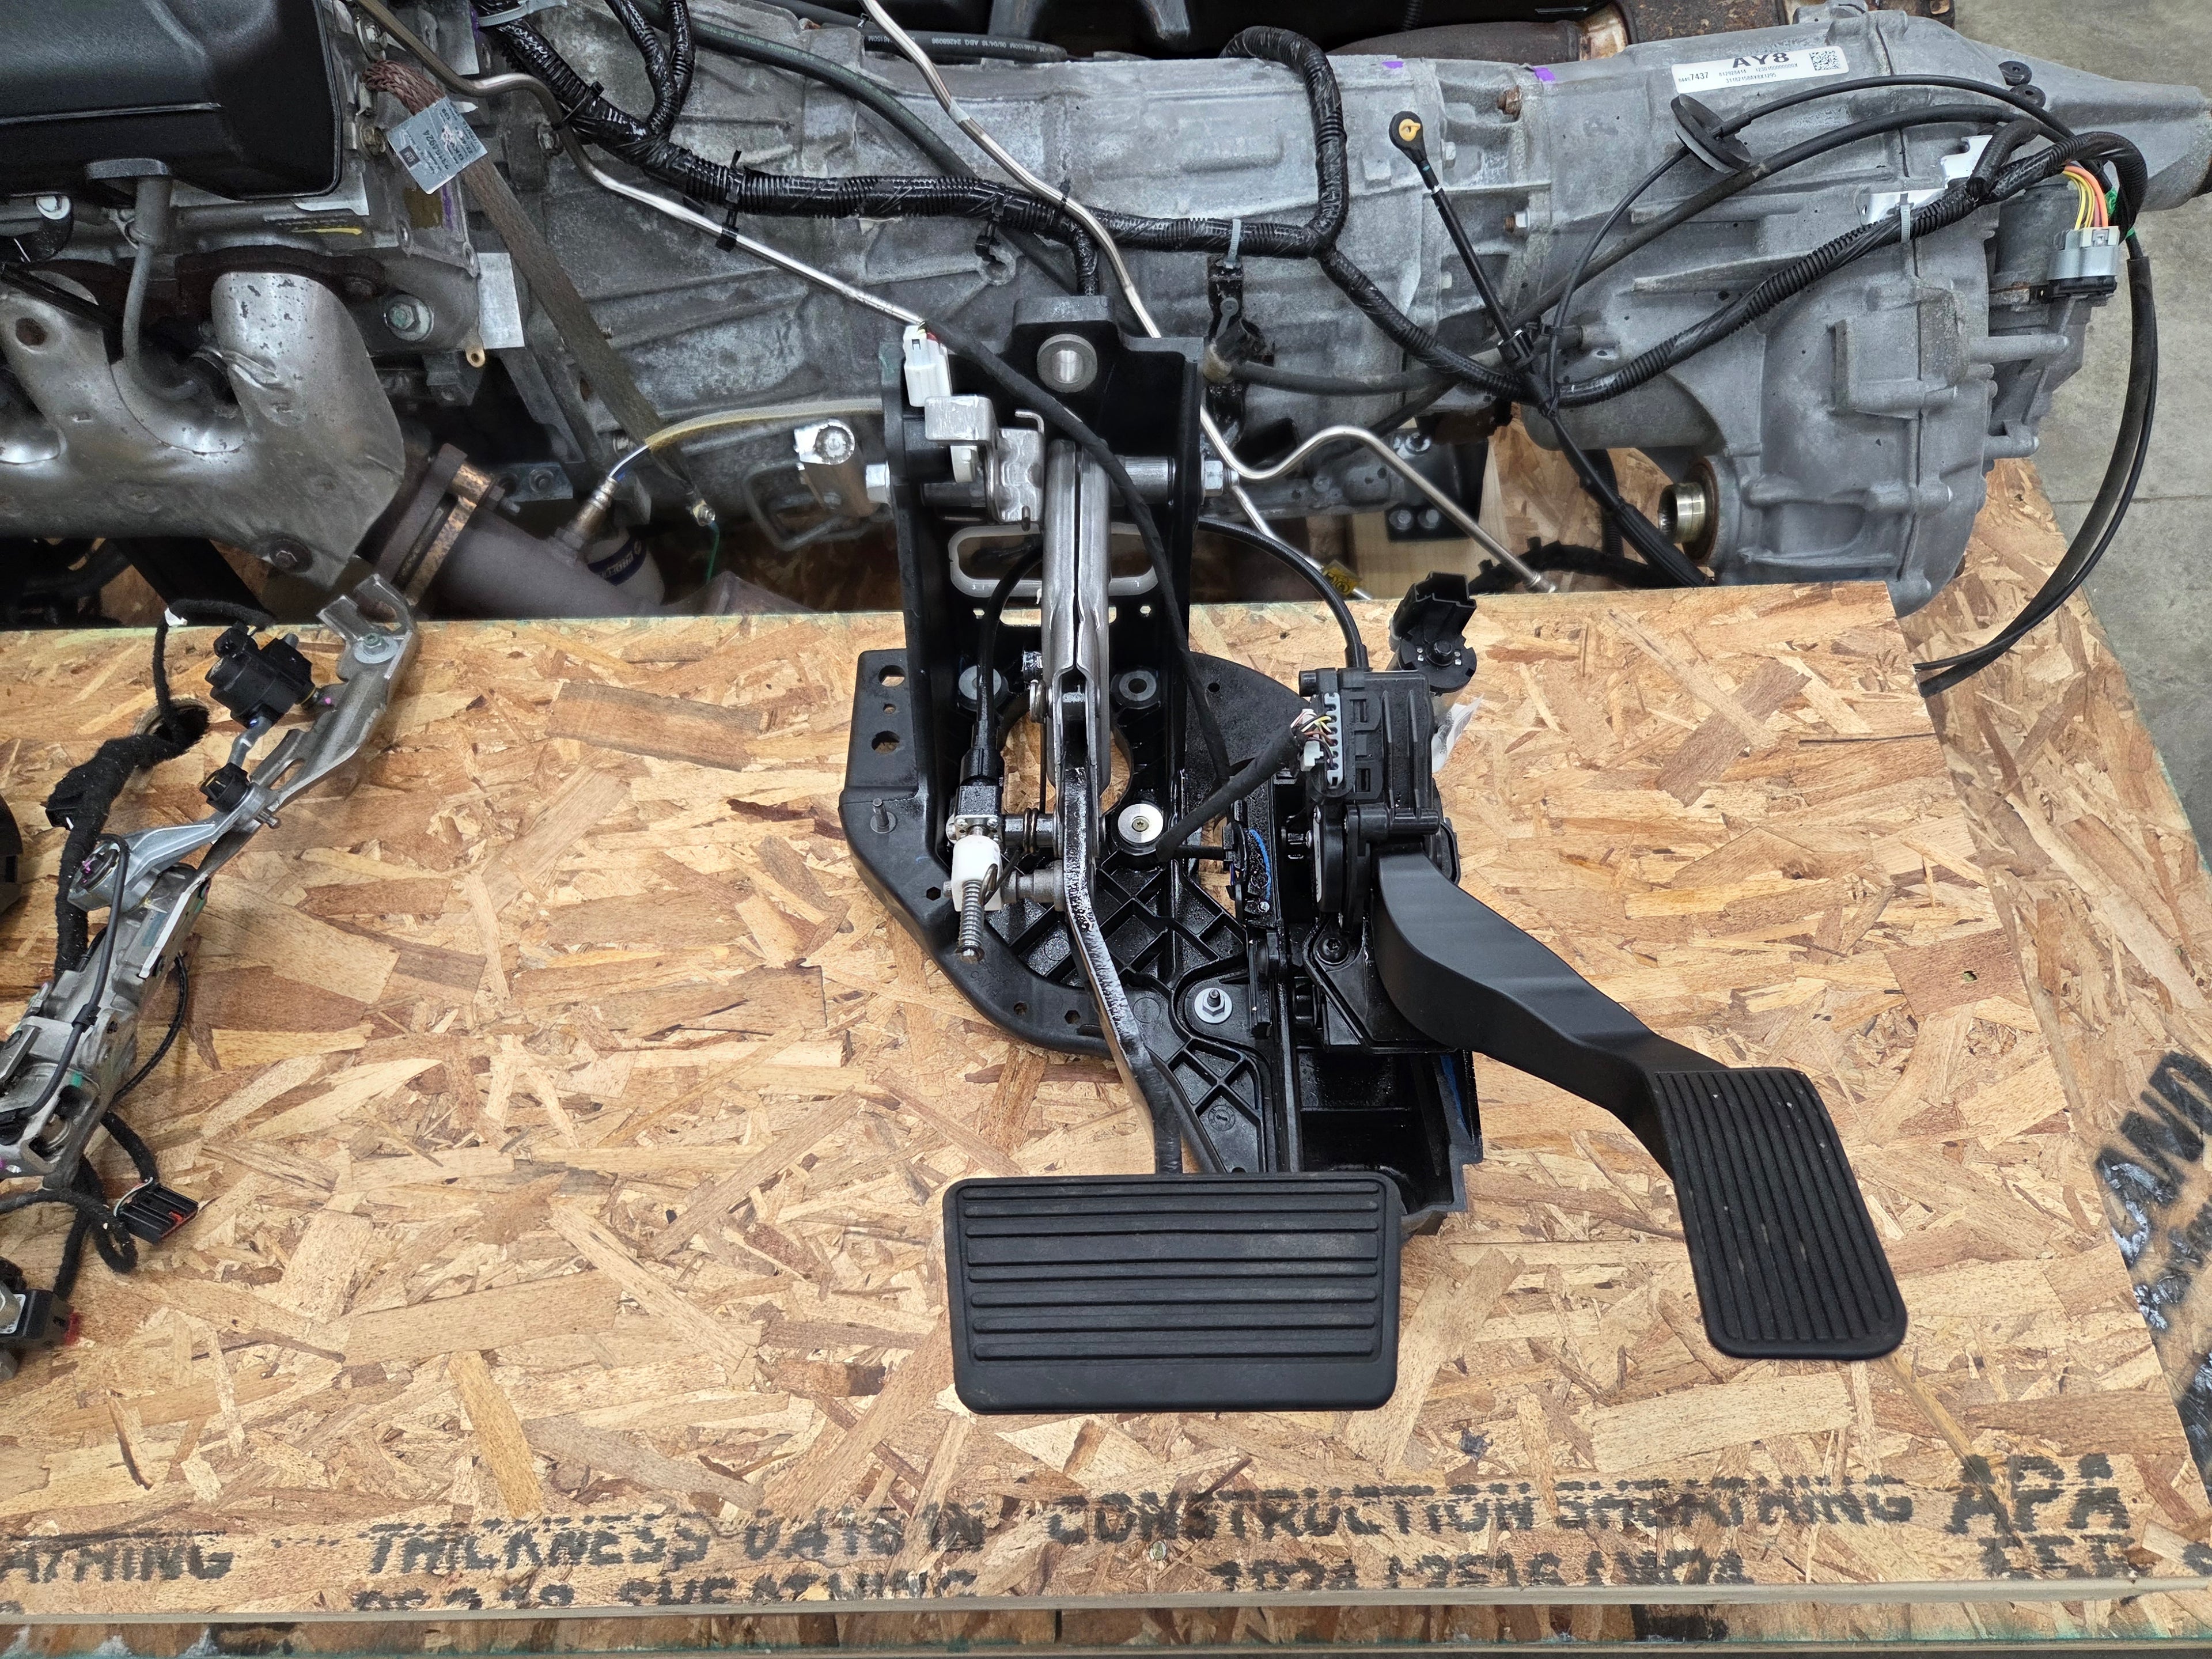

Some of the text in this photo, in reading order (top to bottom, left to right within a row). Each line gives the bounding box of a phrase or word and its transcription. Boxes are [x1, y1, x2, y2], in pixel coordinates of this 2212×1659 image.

[1733, 52, 1790, 69] AY8
[404, 151, 414, 162] GM
[1944, 1452, 2131, 1535] APA
[357, 1509, 709, 1574] THICKNESS
